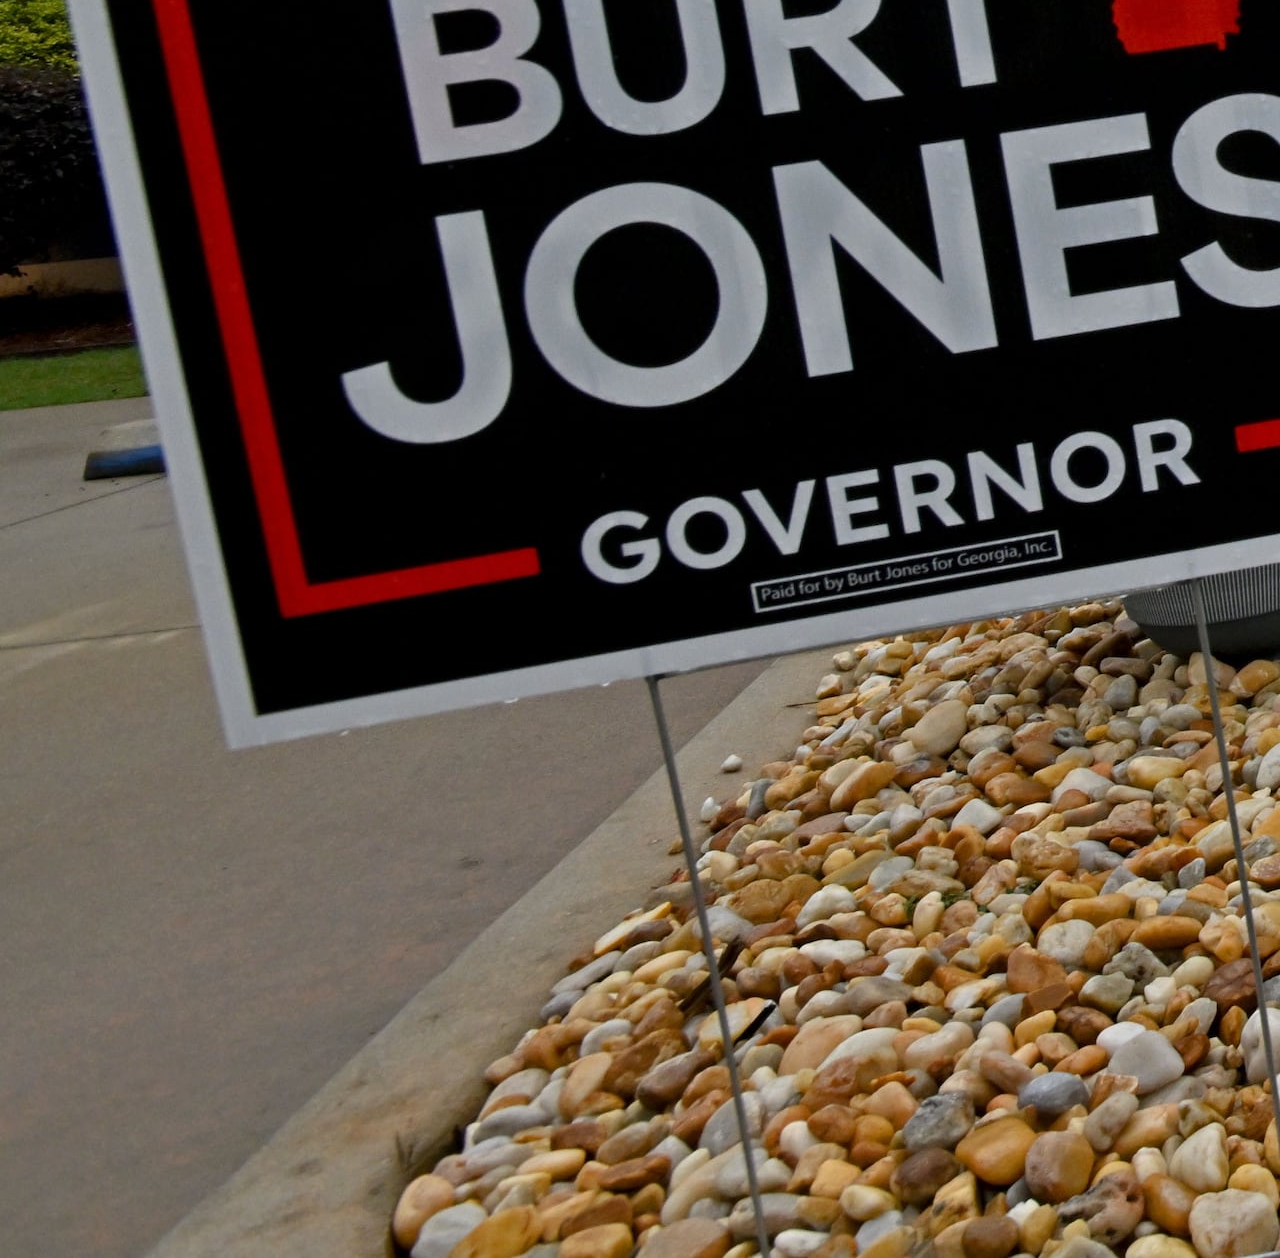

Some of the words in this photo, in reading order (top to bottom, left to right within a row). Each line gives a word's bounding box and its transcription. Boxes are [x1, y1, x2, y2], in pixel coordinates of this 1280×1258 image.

[580, 418, 1202, 585] GOVERNOR
[761, 583, 796, 601] Paid
[799, 579, 821, 595] for
[824, 576, 845, 593] by
[849, 569, 882, 586] Burt
[885, 564, 930, 581] Jones
[932, 558, 954, 573] for
[957, 547, 1022, 568] Georgia,
[1025, 540, 1052, 555] Inc.
